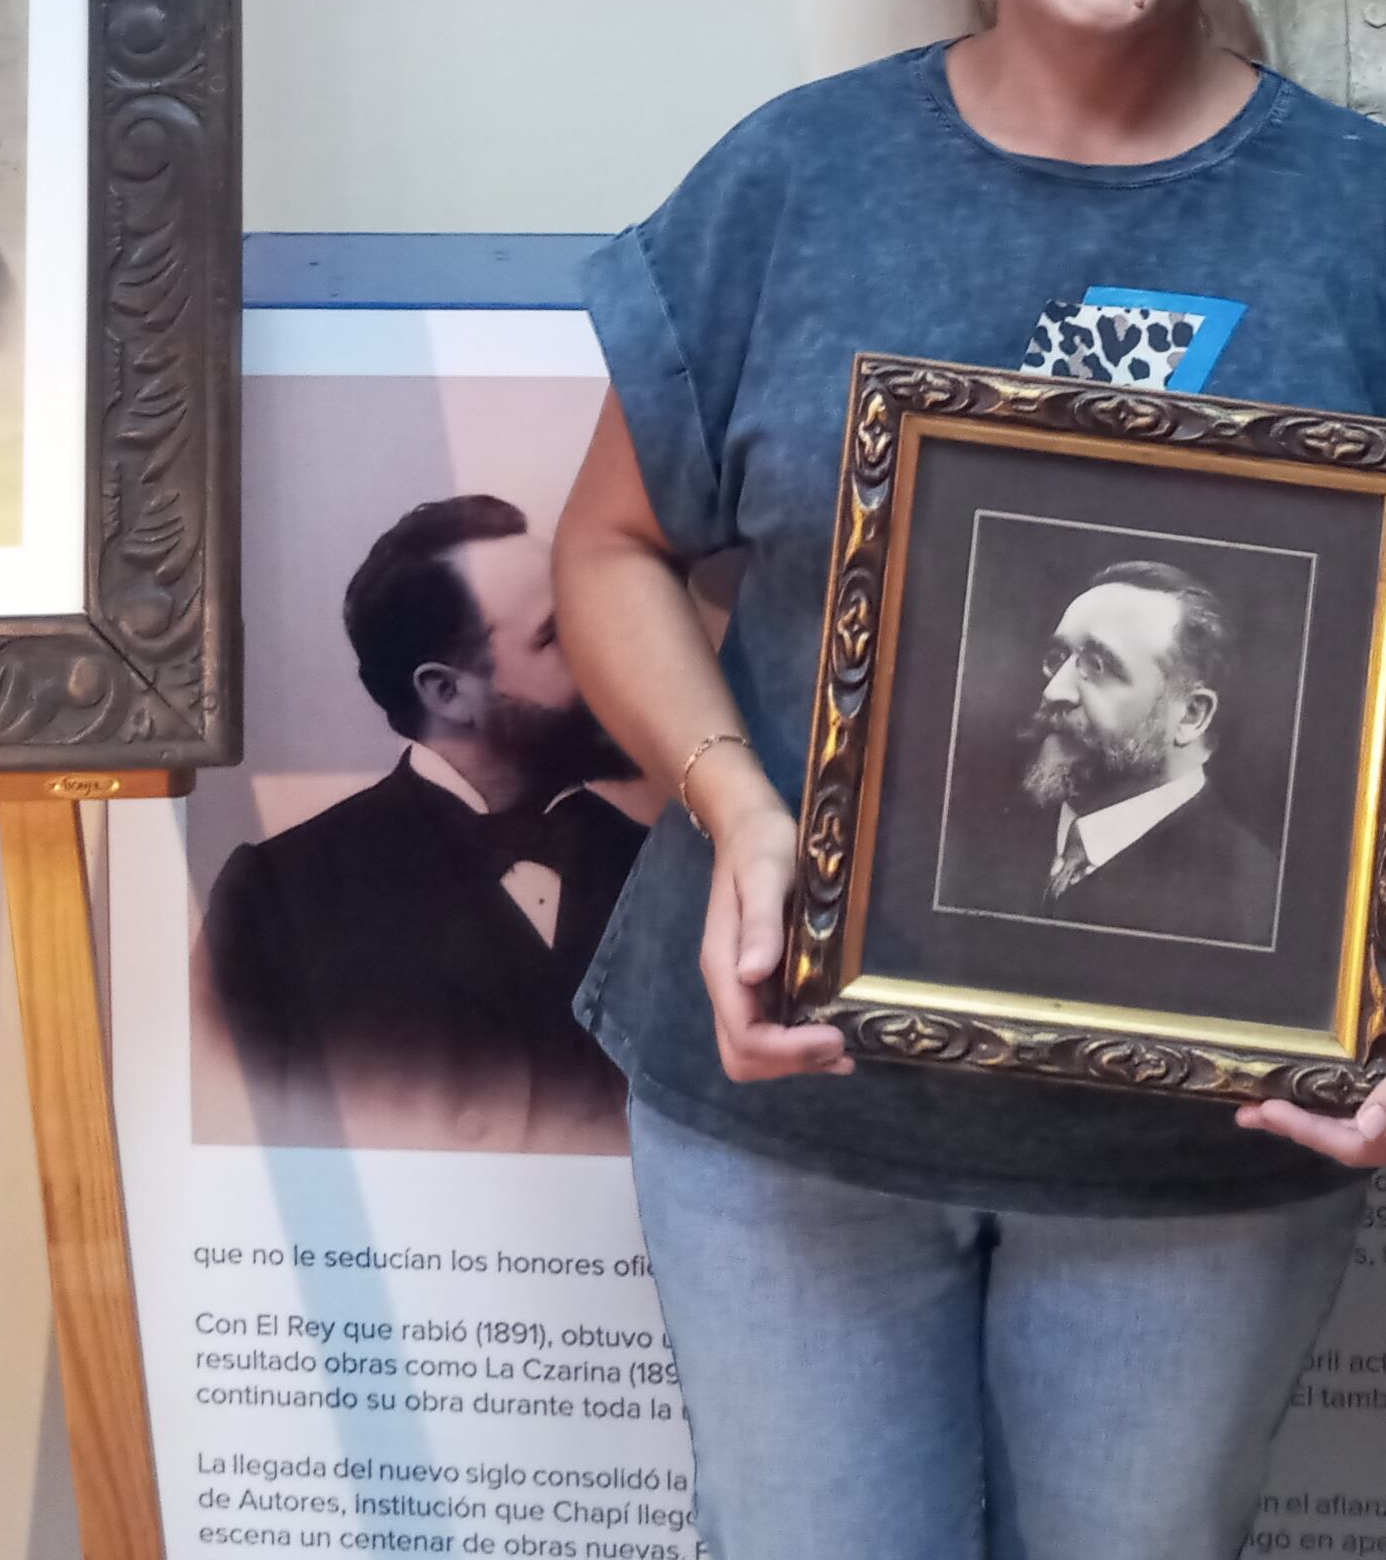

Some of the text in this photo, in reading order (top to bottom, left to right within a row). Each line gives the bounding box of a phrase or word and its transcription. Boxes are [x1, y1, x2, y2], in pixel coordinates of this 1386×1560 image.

[194, 1246, 243, 1269] que
[252, 1247, 284, 1265] no
[293, 1244, 315, 1267] le
[324, 1246, 441, 1270] seducían
[451, 1249, 488, 1273] los
[497, 1251, 605, 1277] honores
[195, 1312, 247, 1336] Con
[256, 1313, 278, 1336] El
[288, 1315, 336, 1344] Rey
[343, 1322, 392, 1343] que
[402, 1320, 467, 1342] rabió
[476, 1321, 553, 1350] (1891),
[561, 1324, 653, 1349] obtuvo
[196, 1350, 317, 1372] resultado
[324, 1352, 397, 1375] obras
[405, 1358, 477, 1377] como
[486, 1356, 514, 1379] La
[523, 1358, 621, 1383] Czarina
[196, 1385, 358, 1410] continuando
[367, 1392, 395, 1410] su
[405, 1390, 463, 1412] obra
[473, 1392, 574, 1416] durante
[583, 1397, 640, 1419] toda
[651, 1398, 671, 1420] la
[198, 1452, 687, 1491] La llegada del nuevo siglo consolidó la
[198, 1488, 230, 1510] de
[238, 1489, 347, 1516] Autores,
[355, 1493, 486, 1518] institución
[495, 1501, 545, 1525] que
[553, 1500, 631, 1529] Chapí
[1286, 1492, 1309, 1514] el
[199, 1526, 291, 1546] escena
[300, 1530, 331, 1548] un
[340, 1529, 455, 1553] centenar
[463, 1533, 495, 1554] de
[504, 1535, 577, 1557] obras
[1300, 1533, 1333, 1550] en
